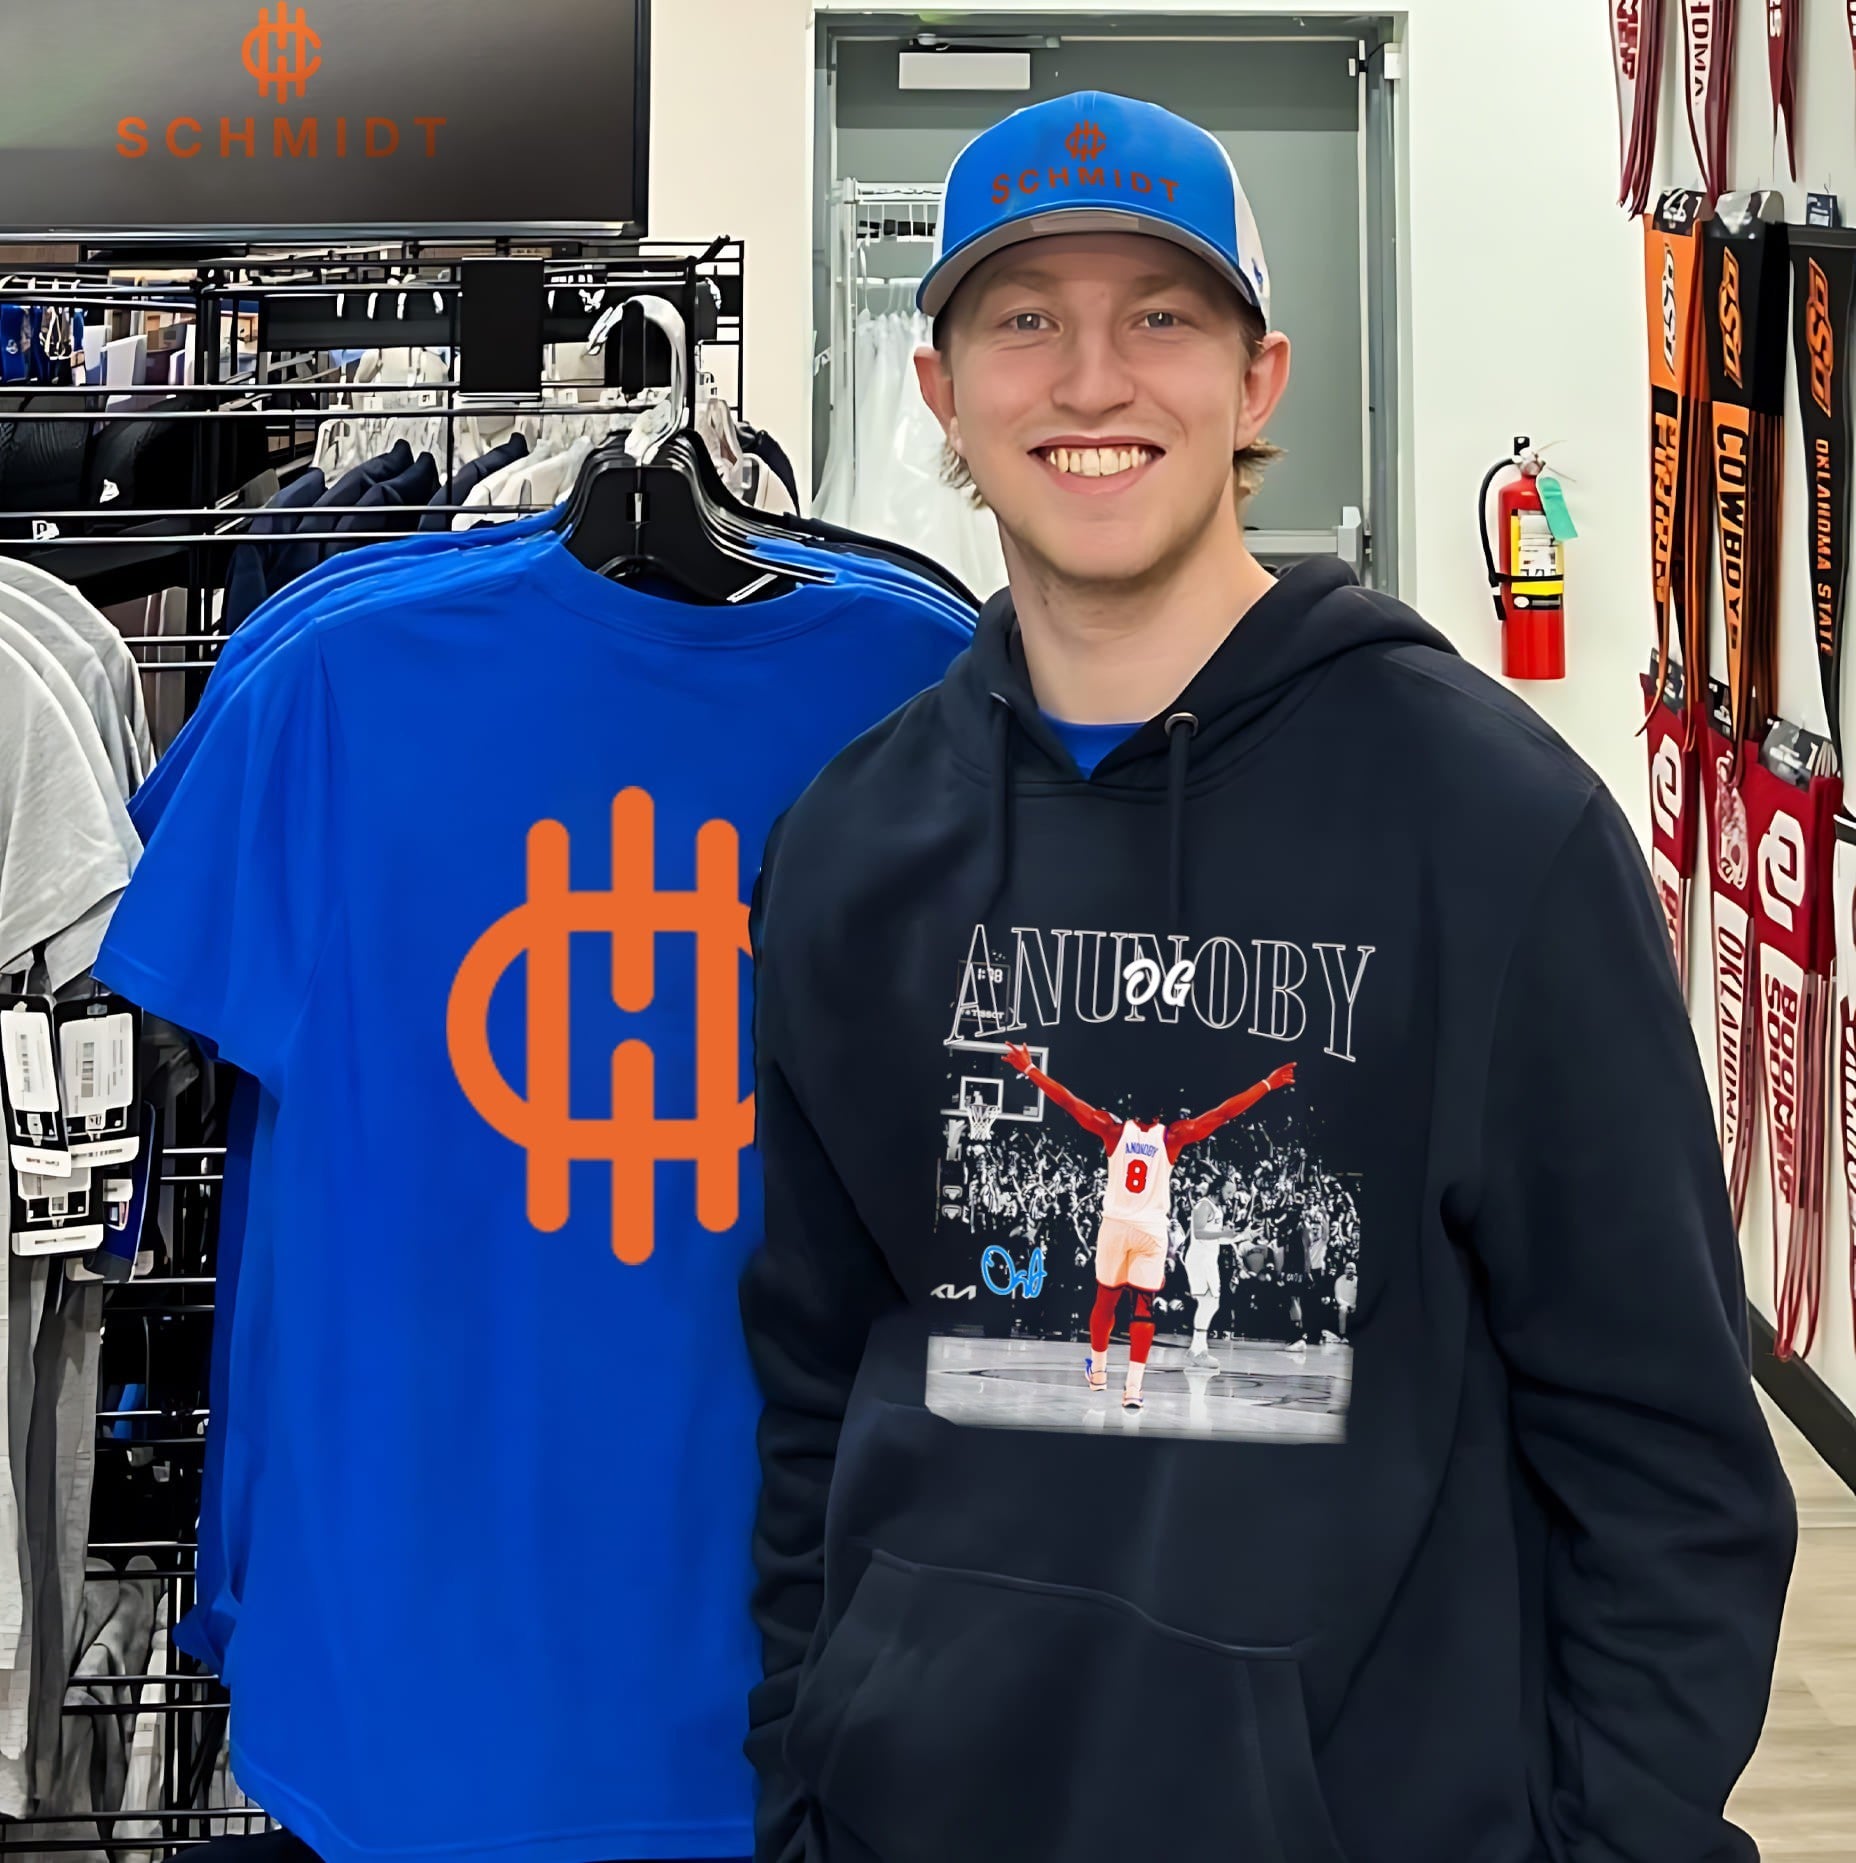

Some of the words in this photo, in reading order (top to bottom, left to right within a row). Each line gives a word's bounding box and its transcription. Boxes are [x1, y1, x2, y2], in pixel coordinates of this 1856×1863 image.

[116, 117, 447, 158] SCHMIDT
[992, 167, 1178, 204] SCHMIDT
[1815, 438, 1832, 570] OKLAHOMA
[943, 924, 1376, 1061] ANUNOBY
[1122, 957, 1195, 1007] OG
[1718, 926, 1745, 1144] OKLAHOMA
[1125, 1159, 1148, 1194] 8
